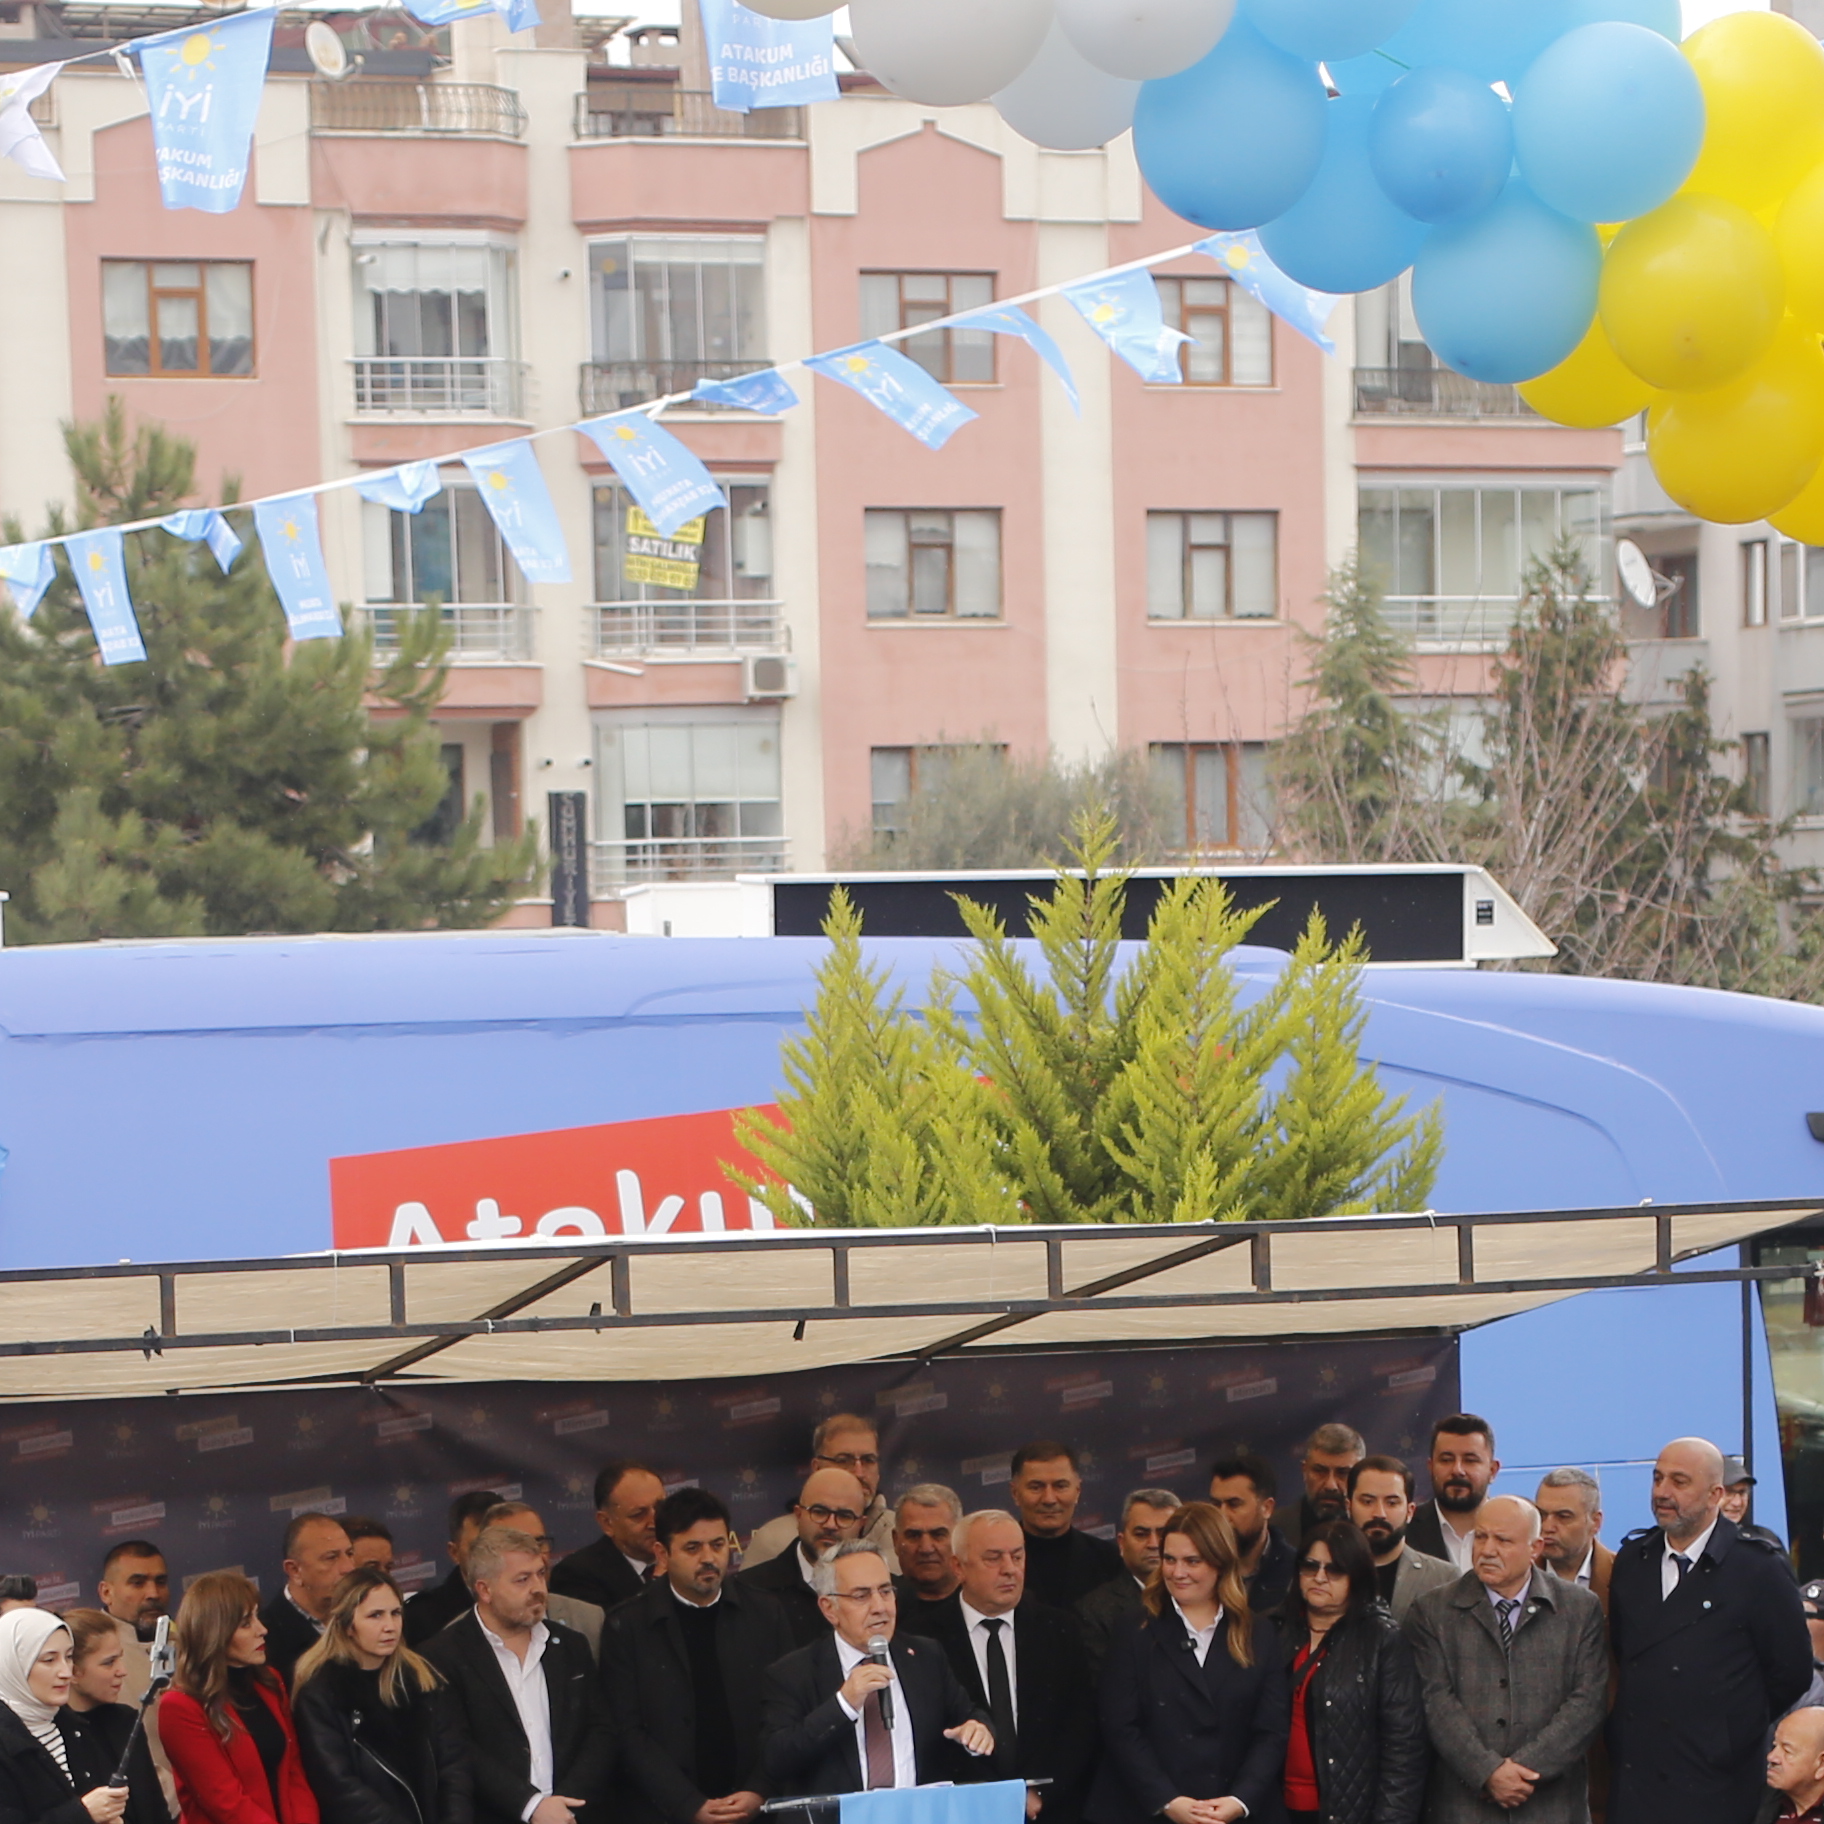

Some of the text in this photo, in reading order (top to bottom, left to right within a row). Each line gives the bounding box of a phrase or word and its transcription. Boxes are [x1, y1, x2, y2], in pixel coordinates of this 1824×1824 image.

[721, 43, 793, 64] ATAKUM
[728, 54, 829, 91] BAŞKANLIĞI
[159, 83, 213, 123] İYİ
[156, 146, 212, 169] AKUM
[159, 166, 240, 189] ŞKANLIĞI
[628, 535, 697, 562] SATILIK
